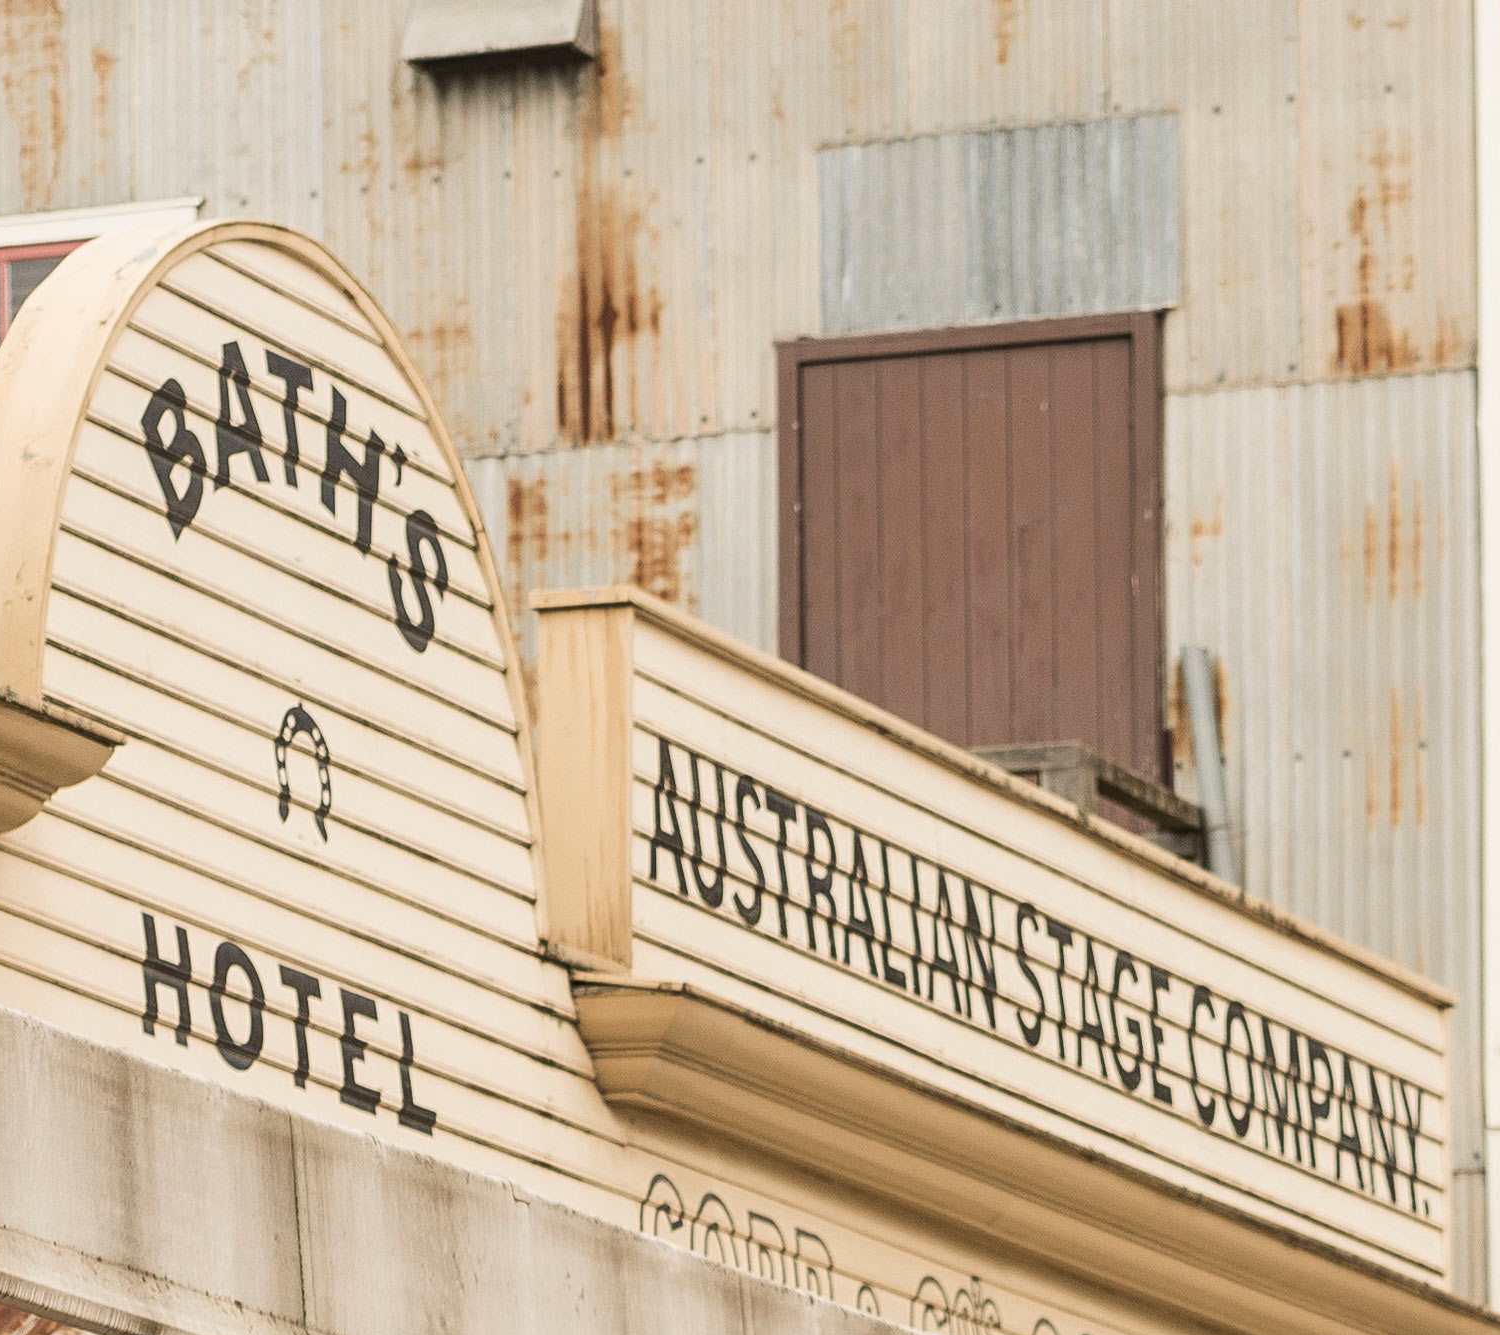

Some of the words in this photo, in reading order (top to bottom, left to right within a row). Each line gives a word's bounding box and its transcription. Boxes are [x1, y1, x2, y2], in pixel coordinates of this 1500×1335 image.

[140, 340, 448, 651] BATH'S
[140, 913, 438, 1135] HOTEL
[650, 737, 997, 1031] AUSTRALIAN
[1015, 901, 1173, 1105] STAGE
[1192, 984, 1432, 1214] COMPANY.
